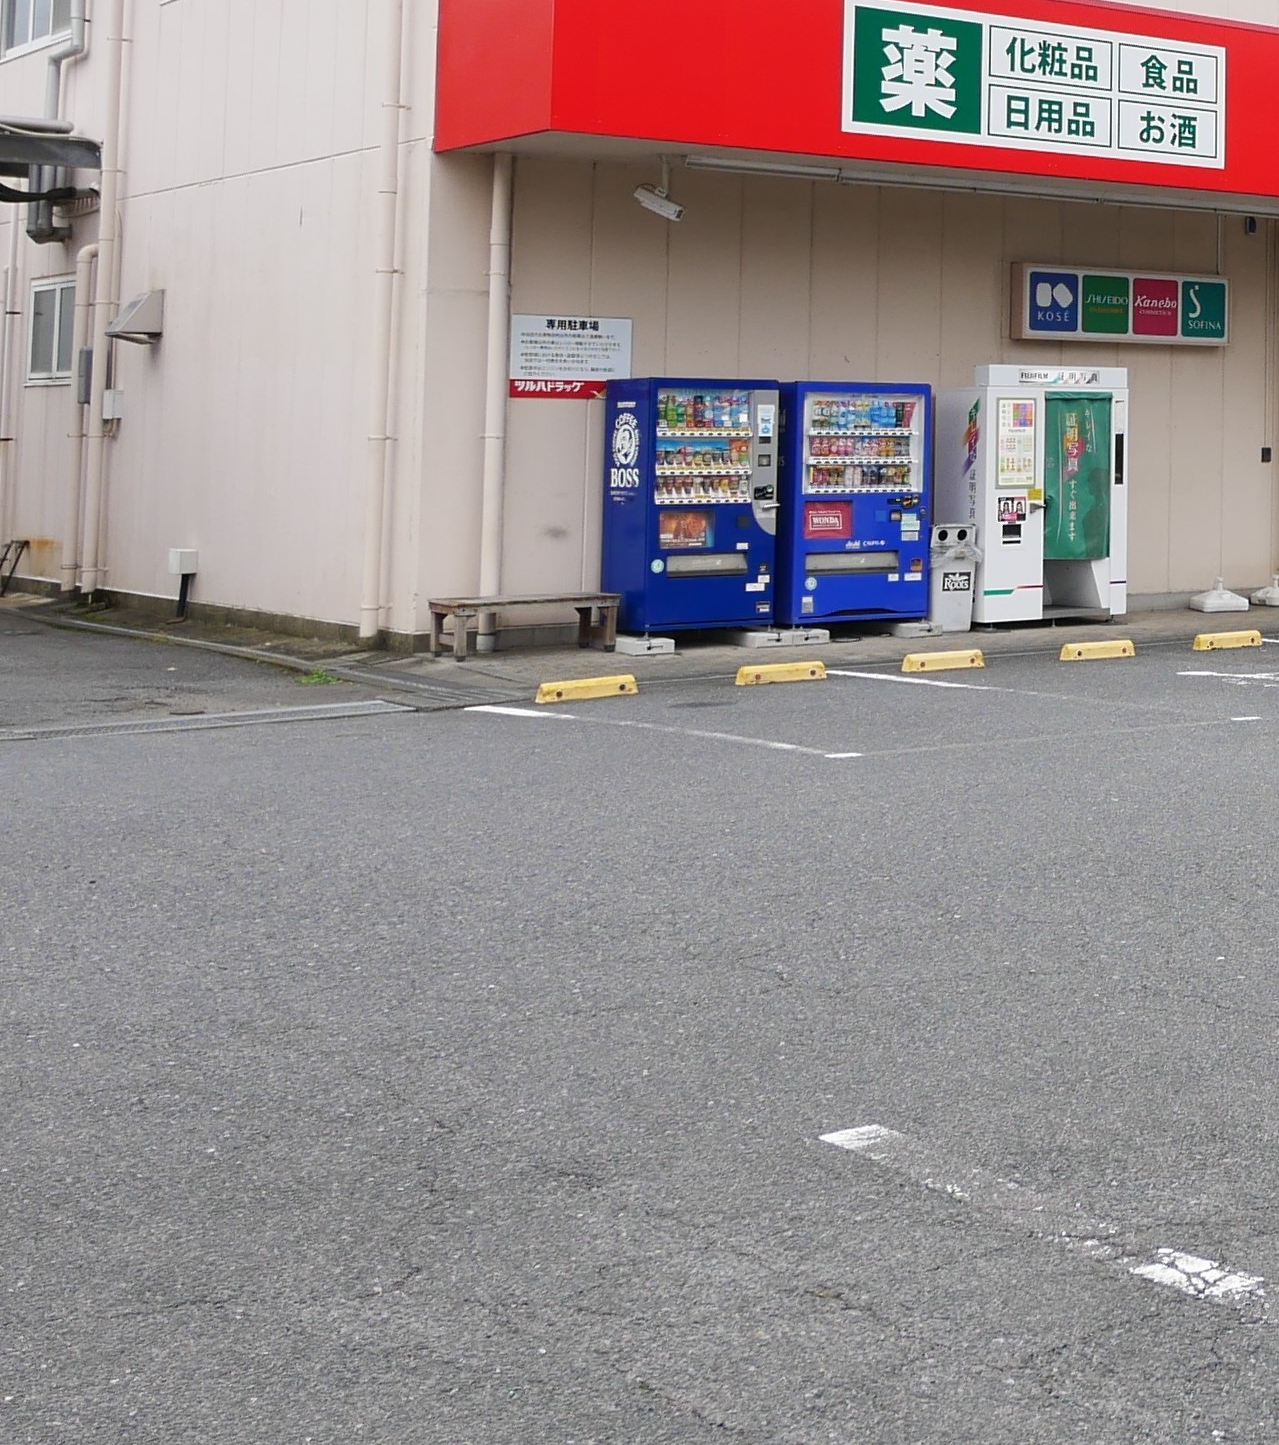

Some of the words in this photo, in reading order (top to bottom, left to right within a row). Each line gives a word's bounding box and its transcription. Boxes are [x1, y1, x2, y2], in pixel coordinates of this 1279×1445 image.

[1006, 36, 1099, 82] 化粧品
[879, 25, 958, 119] 薬
[1140, 54, 1199, 95] 食品
[1005, 94, 1096, 139] 日用品
[1139, 110, 1198, 149] お酒
[1084, 294, 1129, 306] SHISEIDO
[1134, 295, 1178, 309] Kanebo
[546, 319, 600, 332] 専用駐車場
[1187, 319, 1222, 331] SOFINA
[514, 381, 585, 393] ツルハドラッグ
[610, 468, 640, 488] BOSS
